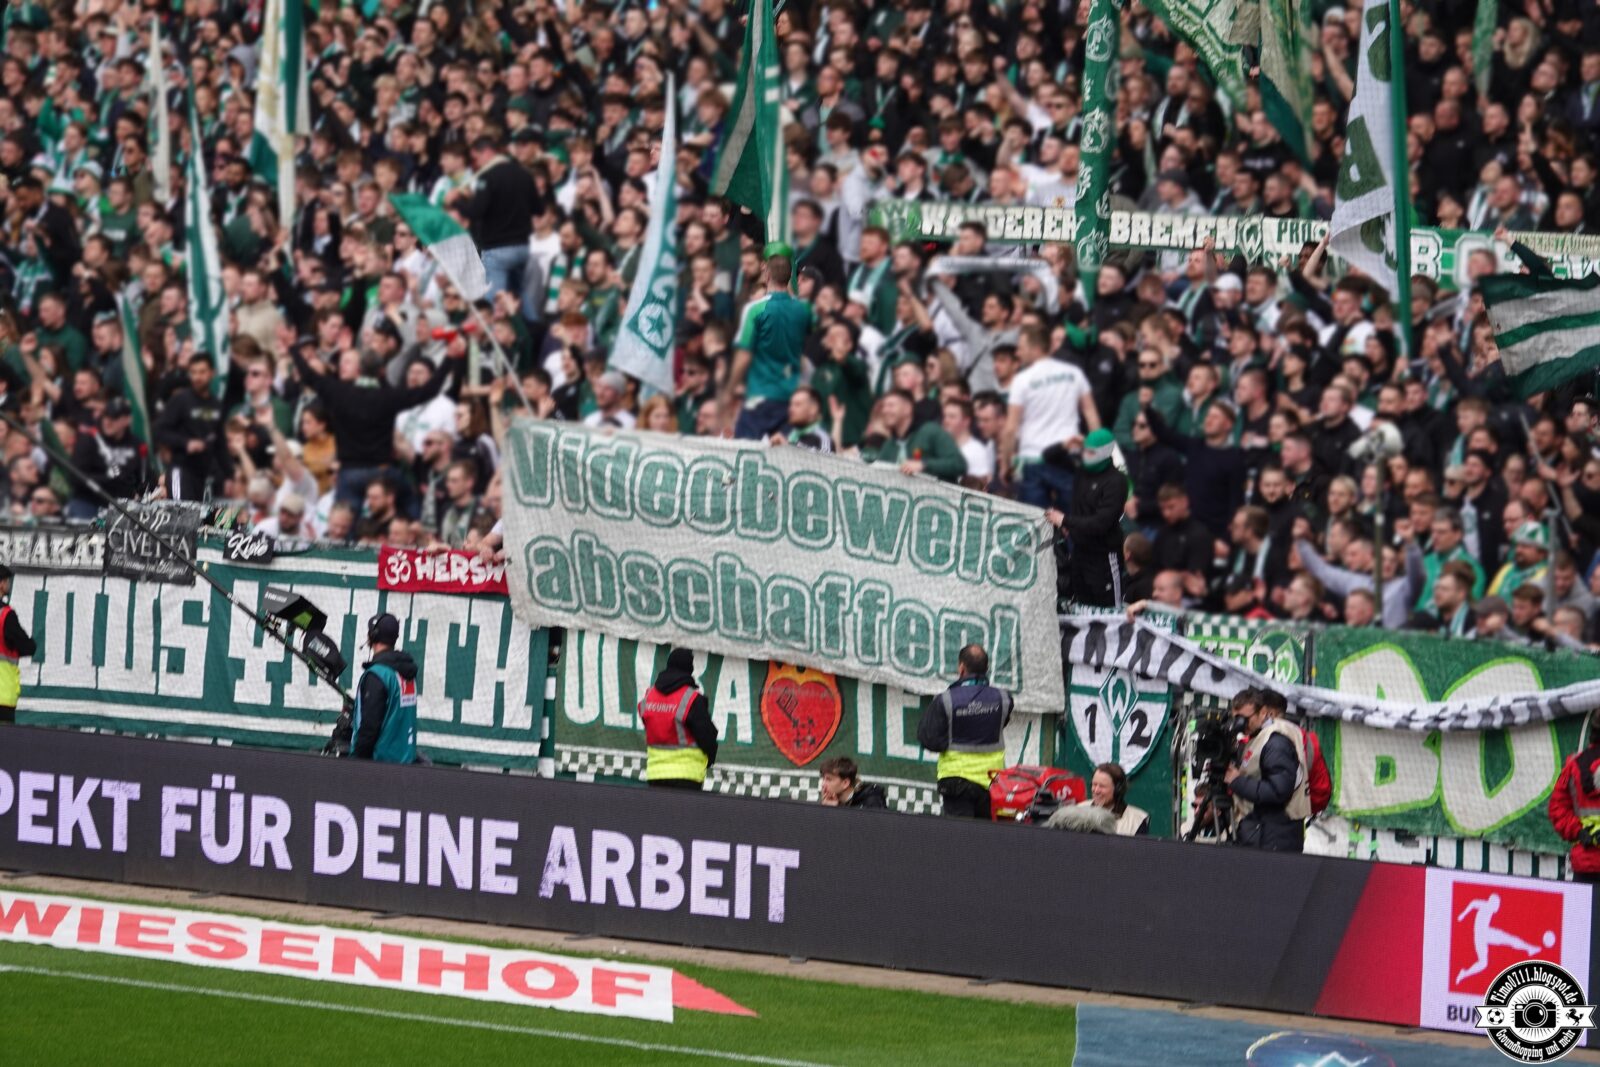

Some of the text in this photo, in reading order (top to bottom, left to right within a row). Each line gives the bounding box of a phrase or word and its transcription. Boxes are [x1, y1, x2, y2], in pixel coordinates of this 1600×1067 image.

[1110, 211, 1238, 249] BREMEN
[509, 424, 1040, 590] Videobeweis
[526, 530, 1023, 692] abschaffen!
[160, 774, 292, 870] FÜR
[313, 801, 519, 895] DEINE
[538, 826, 800, 924] ARBEIT
[0, 898, 656, 1008] WIESENHOF
